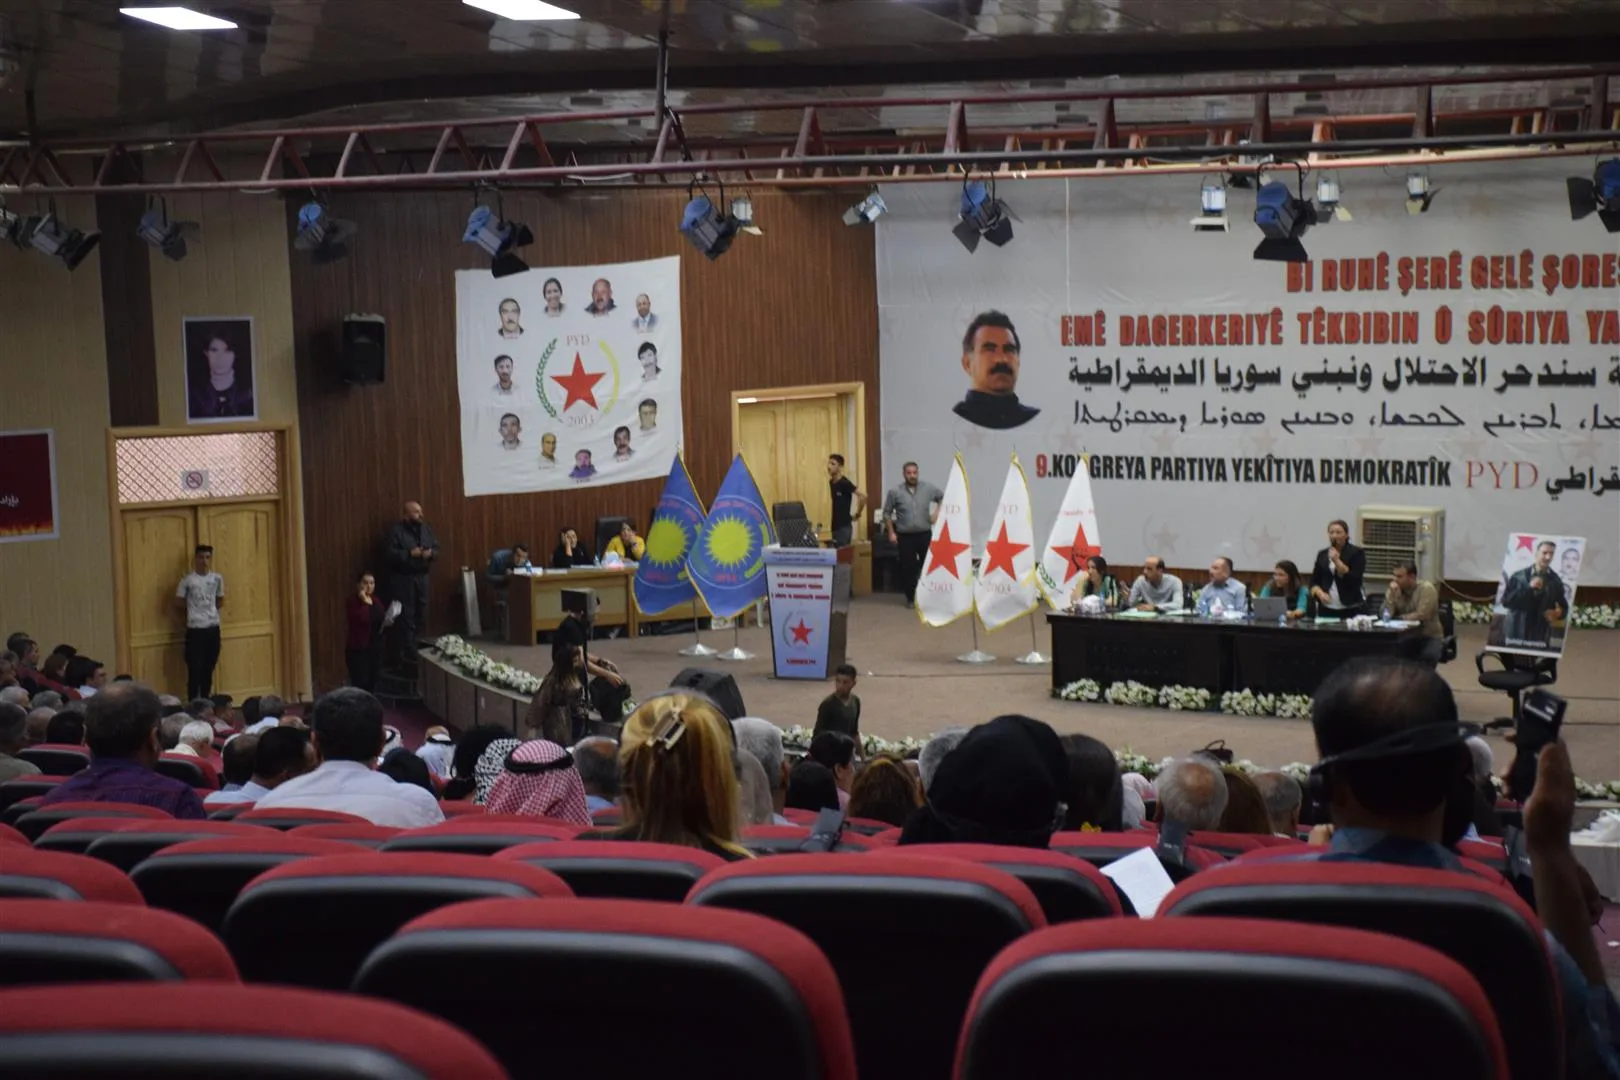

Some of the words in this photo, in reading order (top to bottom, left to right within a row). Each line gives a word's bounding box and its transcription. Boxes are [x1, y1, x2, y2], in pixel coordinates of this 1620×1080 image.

[1287, 260, 1313, 292] BI
[1321, 251, 1389, 291] RUHÊ
[1398, 250, 1462, 296] ŞERÊ
[1471, 249, 1534, 289] GELÊ
[1542, 253, 1620, 296] ŞORE
[566, 335, 591, 346] PYD
[1061, 310, 1106, 347] EMÊ
[1119, 307, 1283, 346] DAGERKERIYÊ
[1297, 306, 1419, 345] TÊKBIBIN
[1434, 305, 1452, 345] Û
[1468, 304, 1570, 345] SÛRIYA
[1068, 356, 1205, 393] الديمقراطية
[1214, 357, 1281, 392] سوريا
[1291, 355, 1373, 398] ونبني
[1383, 355, 1487, 392] الاحتلال
[1494, 358, 1597, 393] سندحر
[1035, 452, 1146, 480] 9.KOGREYA
[1150, 455, 1228, 482] PARTIYA
[1231, 453, 1317, 484] YEKÎTIYA
[1319, 456, 1452, 486] DEMOKRATÎK
[1466, 460, 1539, 490] PYD
